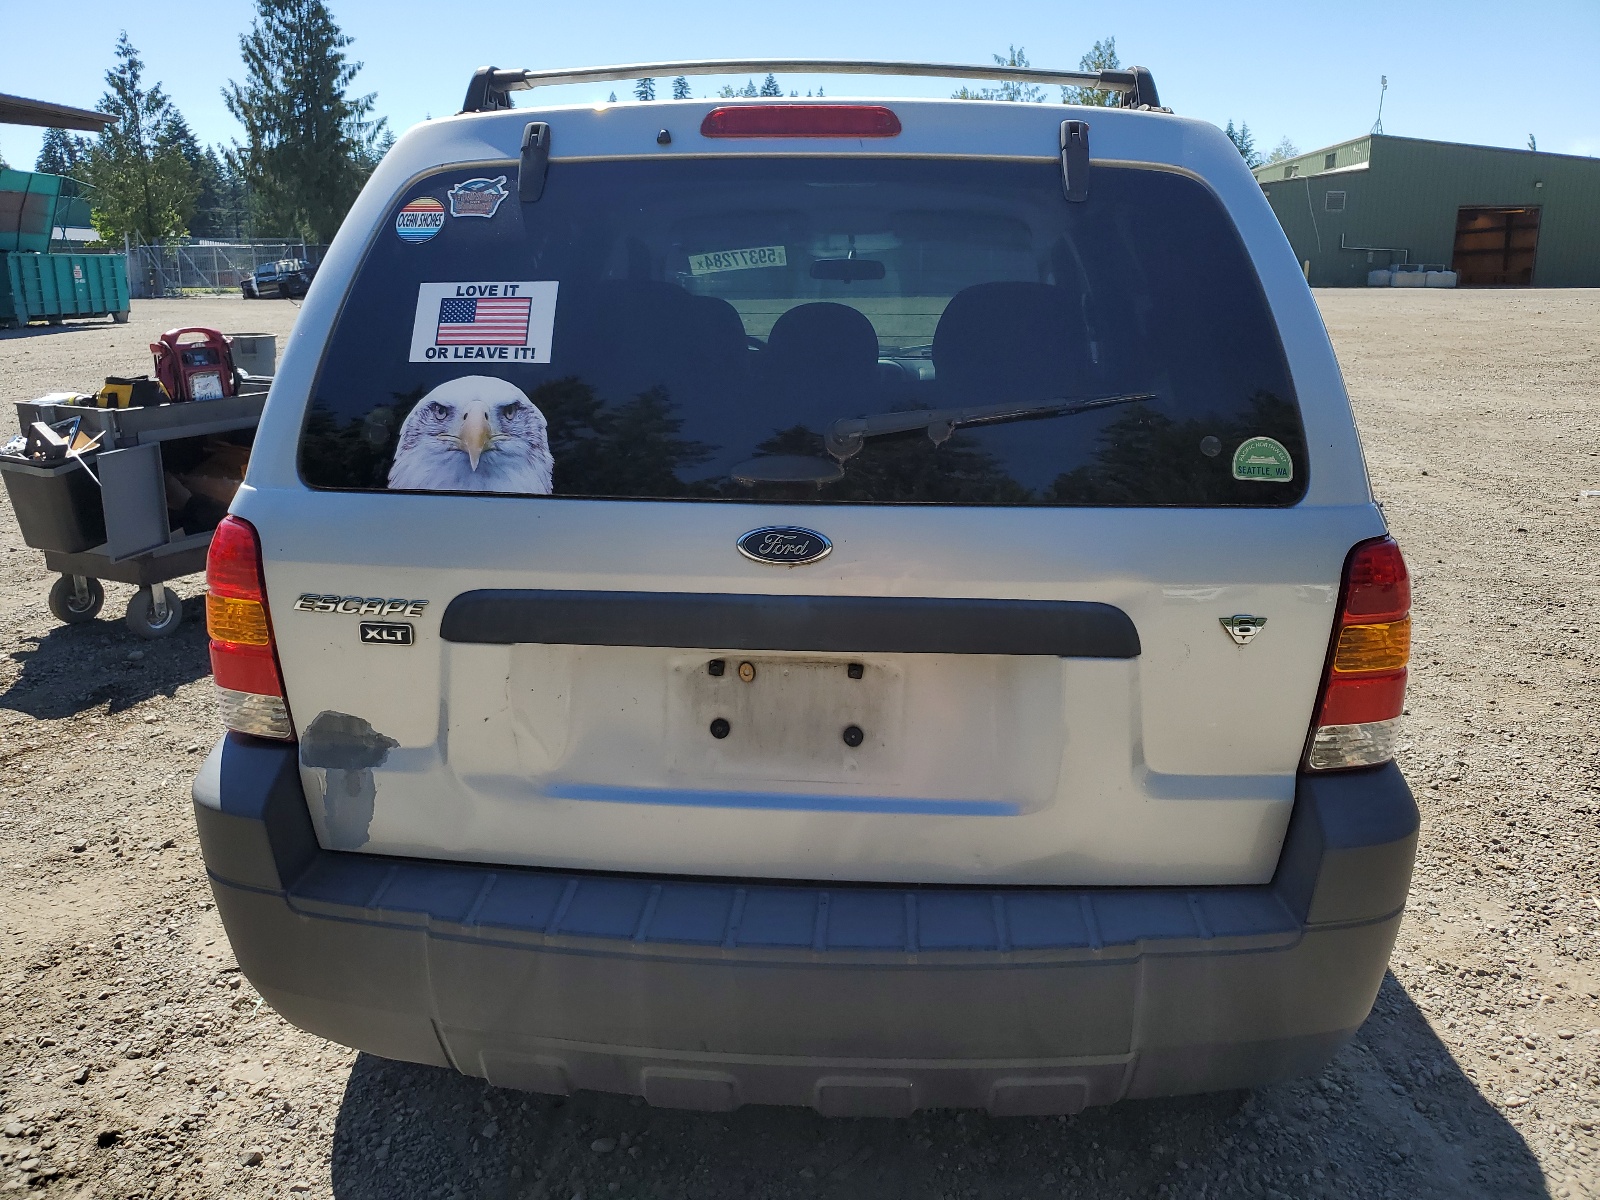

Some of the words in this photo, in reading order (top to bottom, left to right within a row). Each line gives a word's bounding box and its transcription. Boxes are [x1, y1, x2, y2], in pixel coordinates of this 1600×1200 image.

[398, 213, 419, 227] OCEAN
[418, 213, 443, 227] SHORES
[456, 285, 498, 296] LOVE
[503, 285, 519, 296] IT
[425, 347, 448, 359] OR
[454, 347, 508, 359] LEAVE
[514, 348, 535, 359] IT!
[1238, 466, 1273, 476] SEATTLE,
[1276, 468, 1288, 476] WA
[758, 533, 810, 555] Ford
[293, 593, 430, 617] ESCAPE
[365, 628, 406, 640] XLT
